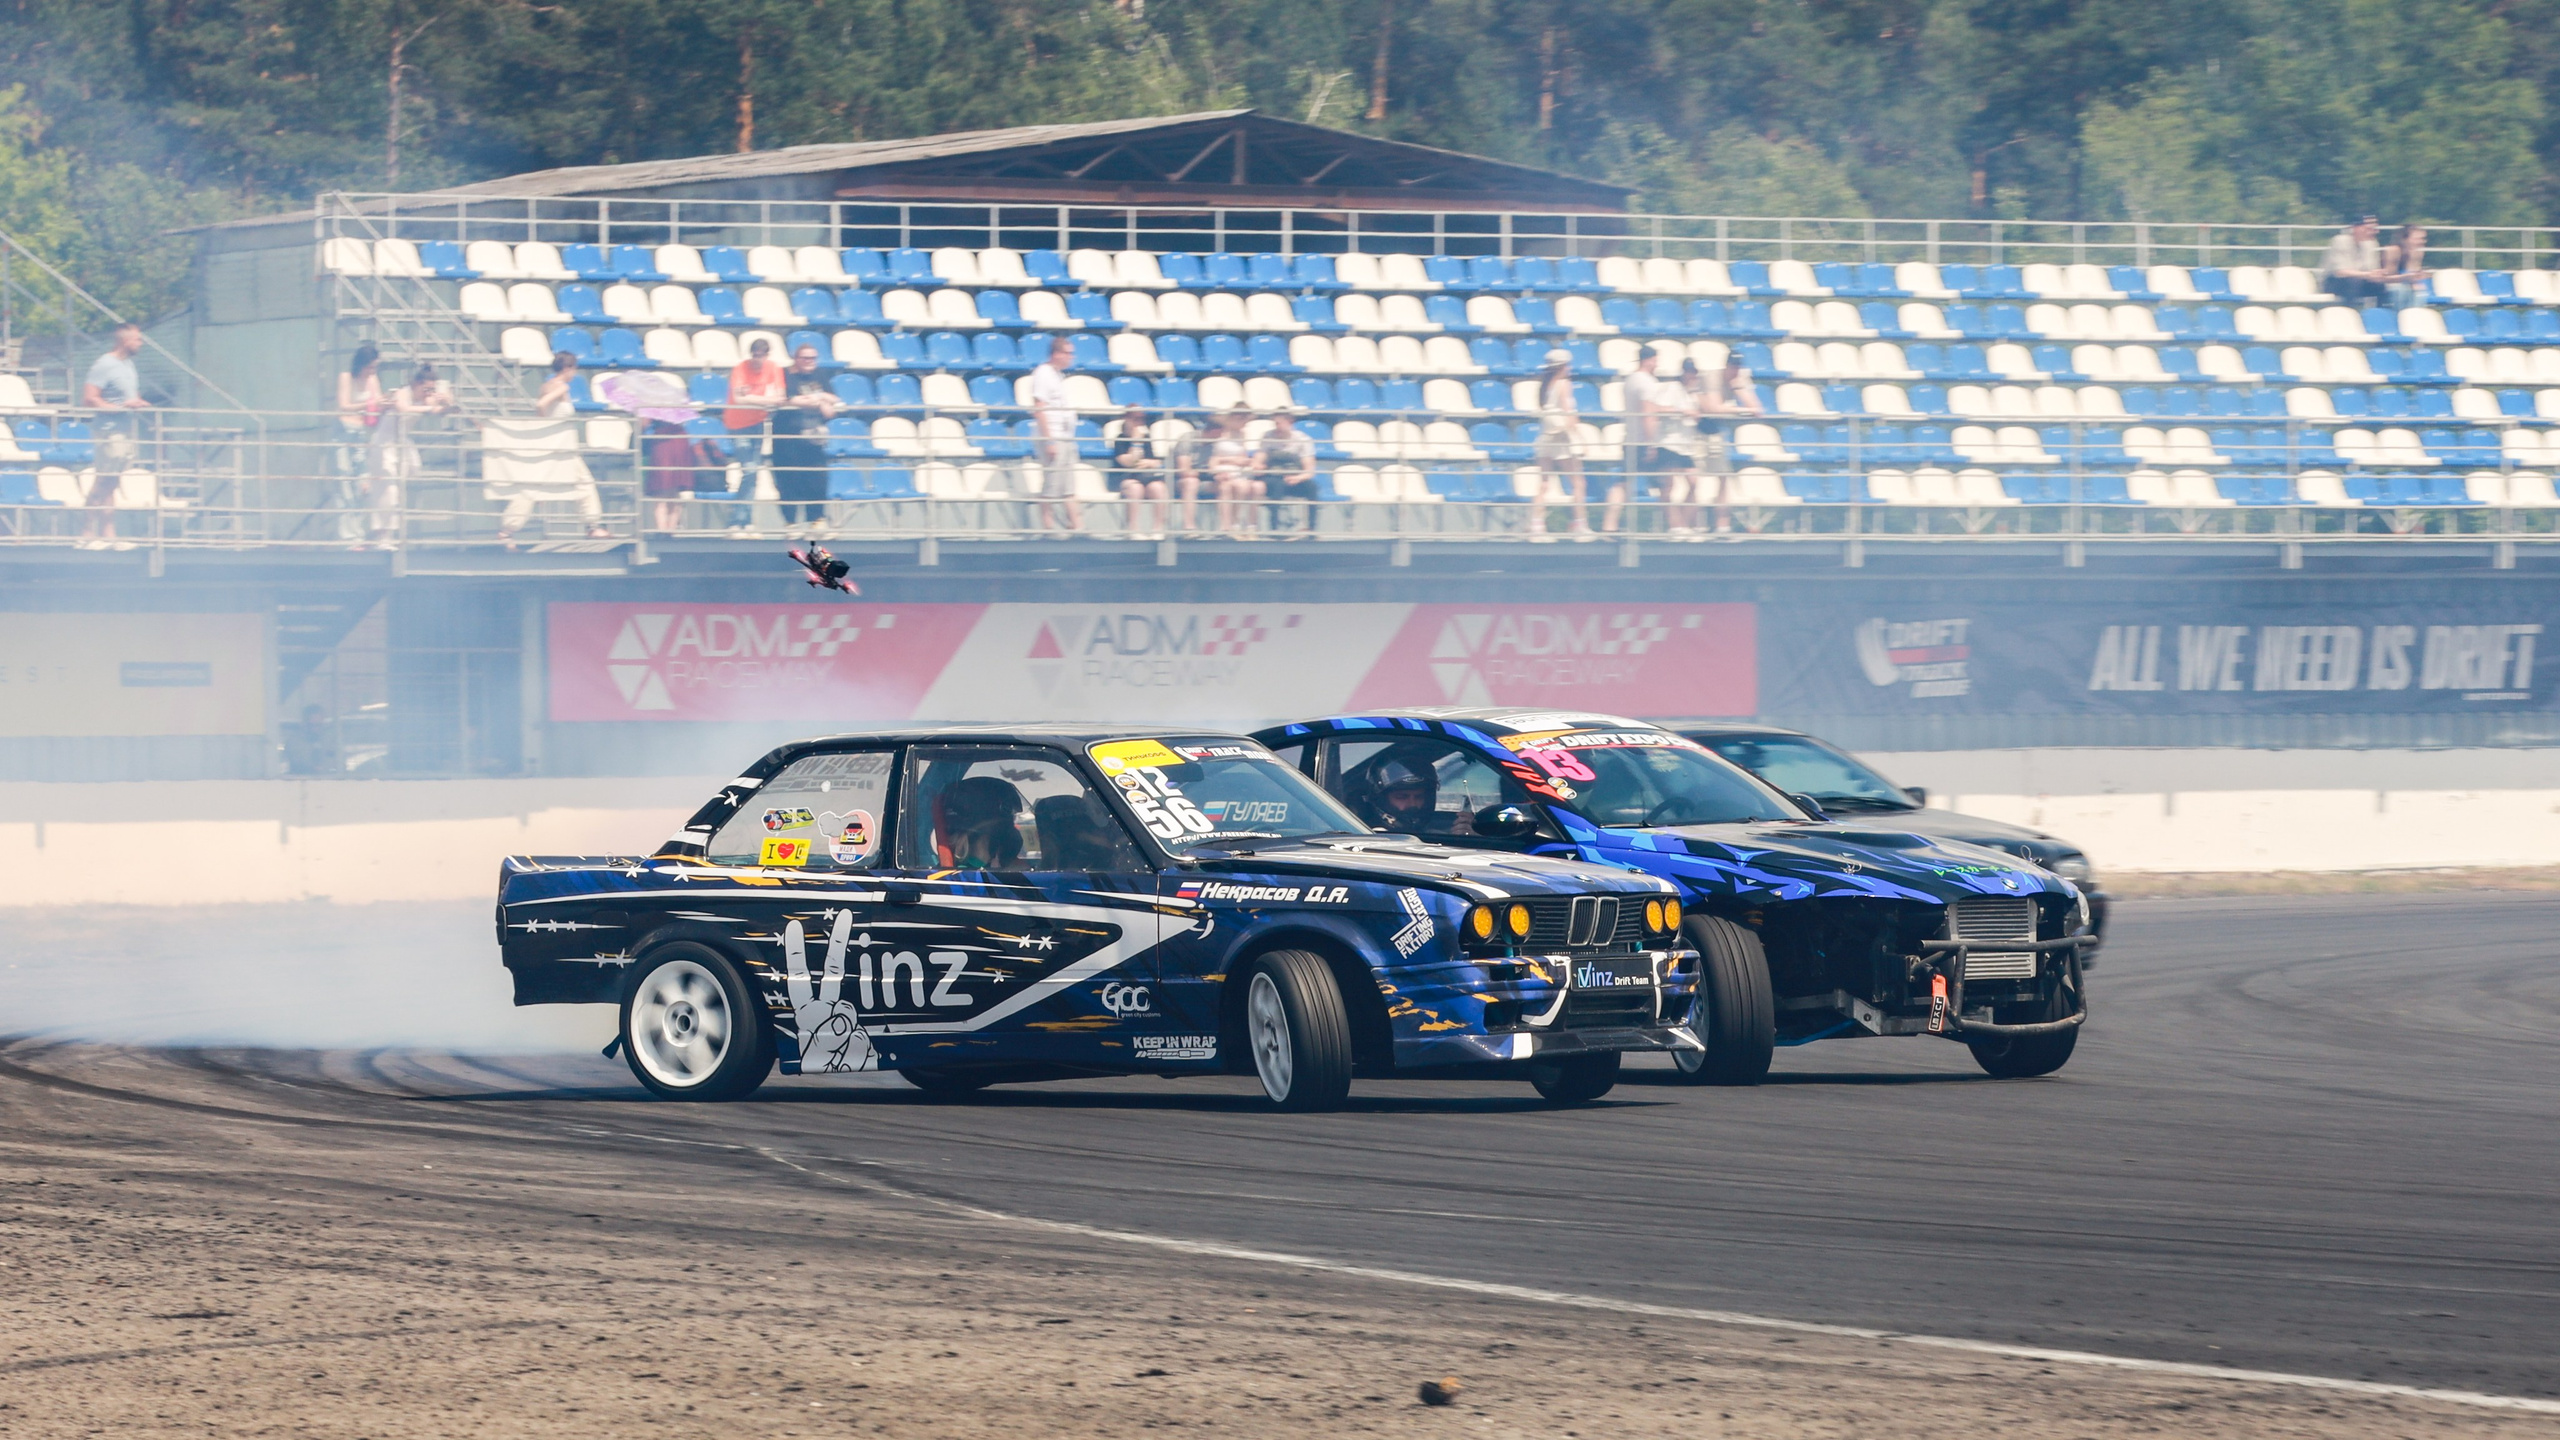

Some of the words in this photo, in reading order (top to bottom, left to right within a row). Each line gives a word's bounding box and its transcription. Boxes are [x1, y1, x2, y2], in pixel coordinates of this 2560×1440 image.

[668, 614, 790, 656] ADM
[1084, 614, 1200, 656] ADM
[1488, 614, 1601, 654] ADM
[2088, 625, 2164, 690] ALL
[2178, 625, 2249, 690] WE
[2253, 626, 2362, 691] NEED
[2367, 625, 2417, 690] IS
[2420, 624, 2543, 689] DRIFT
[1560, 734, 1622, 747] DRIFT
[1518, 748, 1597, 781] 13
[1124, 766, 1184, 798] 12
[1131, 797, 1214, 839] 56
[1222, 801, 1289, 823] ГУЛЯЕВ
[1200, 882, 1300, 903] Некрасов
[1304, 886, 1349, 903] Д.А.
[1394, 915, 1434, 951] DRIFTING
[1400, 926, 1435, 959] FACTORY
[1578, 961, 1613, 987] Vinz
[1615, 976, 1631, 986] Drift
[1632, 976, 1649, 985] Team
[1132, 1036, 1165, 1049] KEEP
[1166, 1036, 1180, 1048] IN
[1181, 1036, 1217, 1048] WRAP
